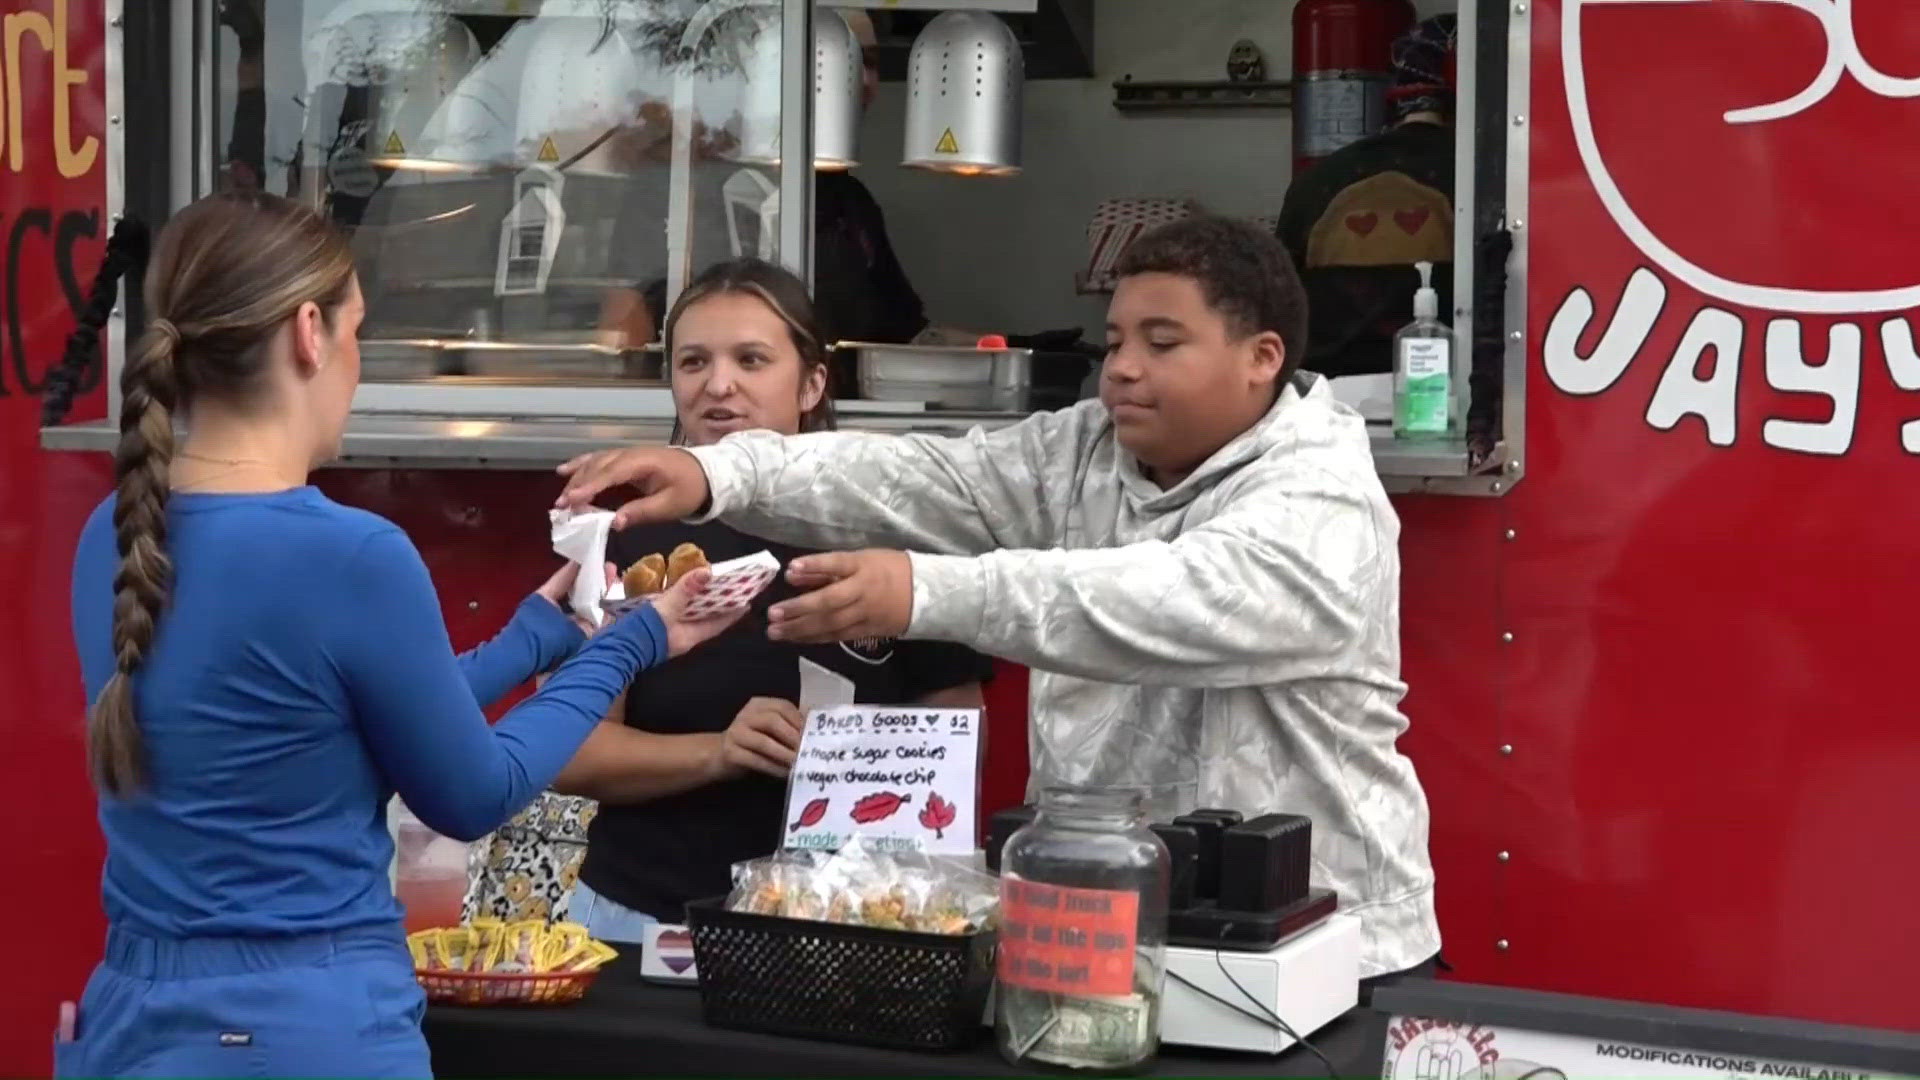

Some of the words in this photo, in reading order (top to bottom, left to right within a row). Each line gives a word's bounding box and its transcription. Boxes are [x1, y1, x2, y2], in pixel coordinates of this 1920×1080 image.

[0, 0, 98, 178] rt
[0, 207, 104, 396] CS
[816, 713, 864, 731] BAKED
[872, 712, 918, 726] GOODS
[951, 715, 970, 729] $2
[806, 771, 839, 792] vegan
[798, 831, 838, 848] made
[1596, 1043, 1757, 1073] MODIFICATIONS
